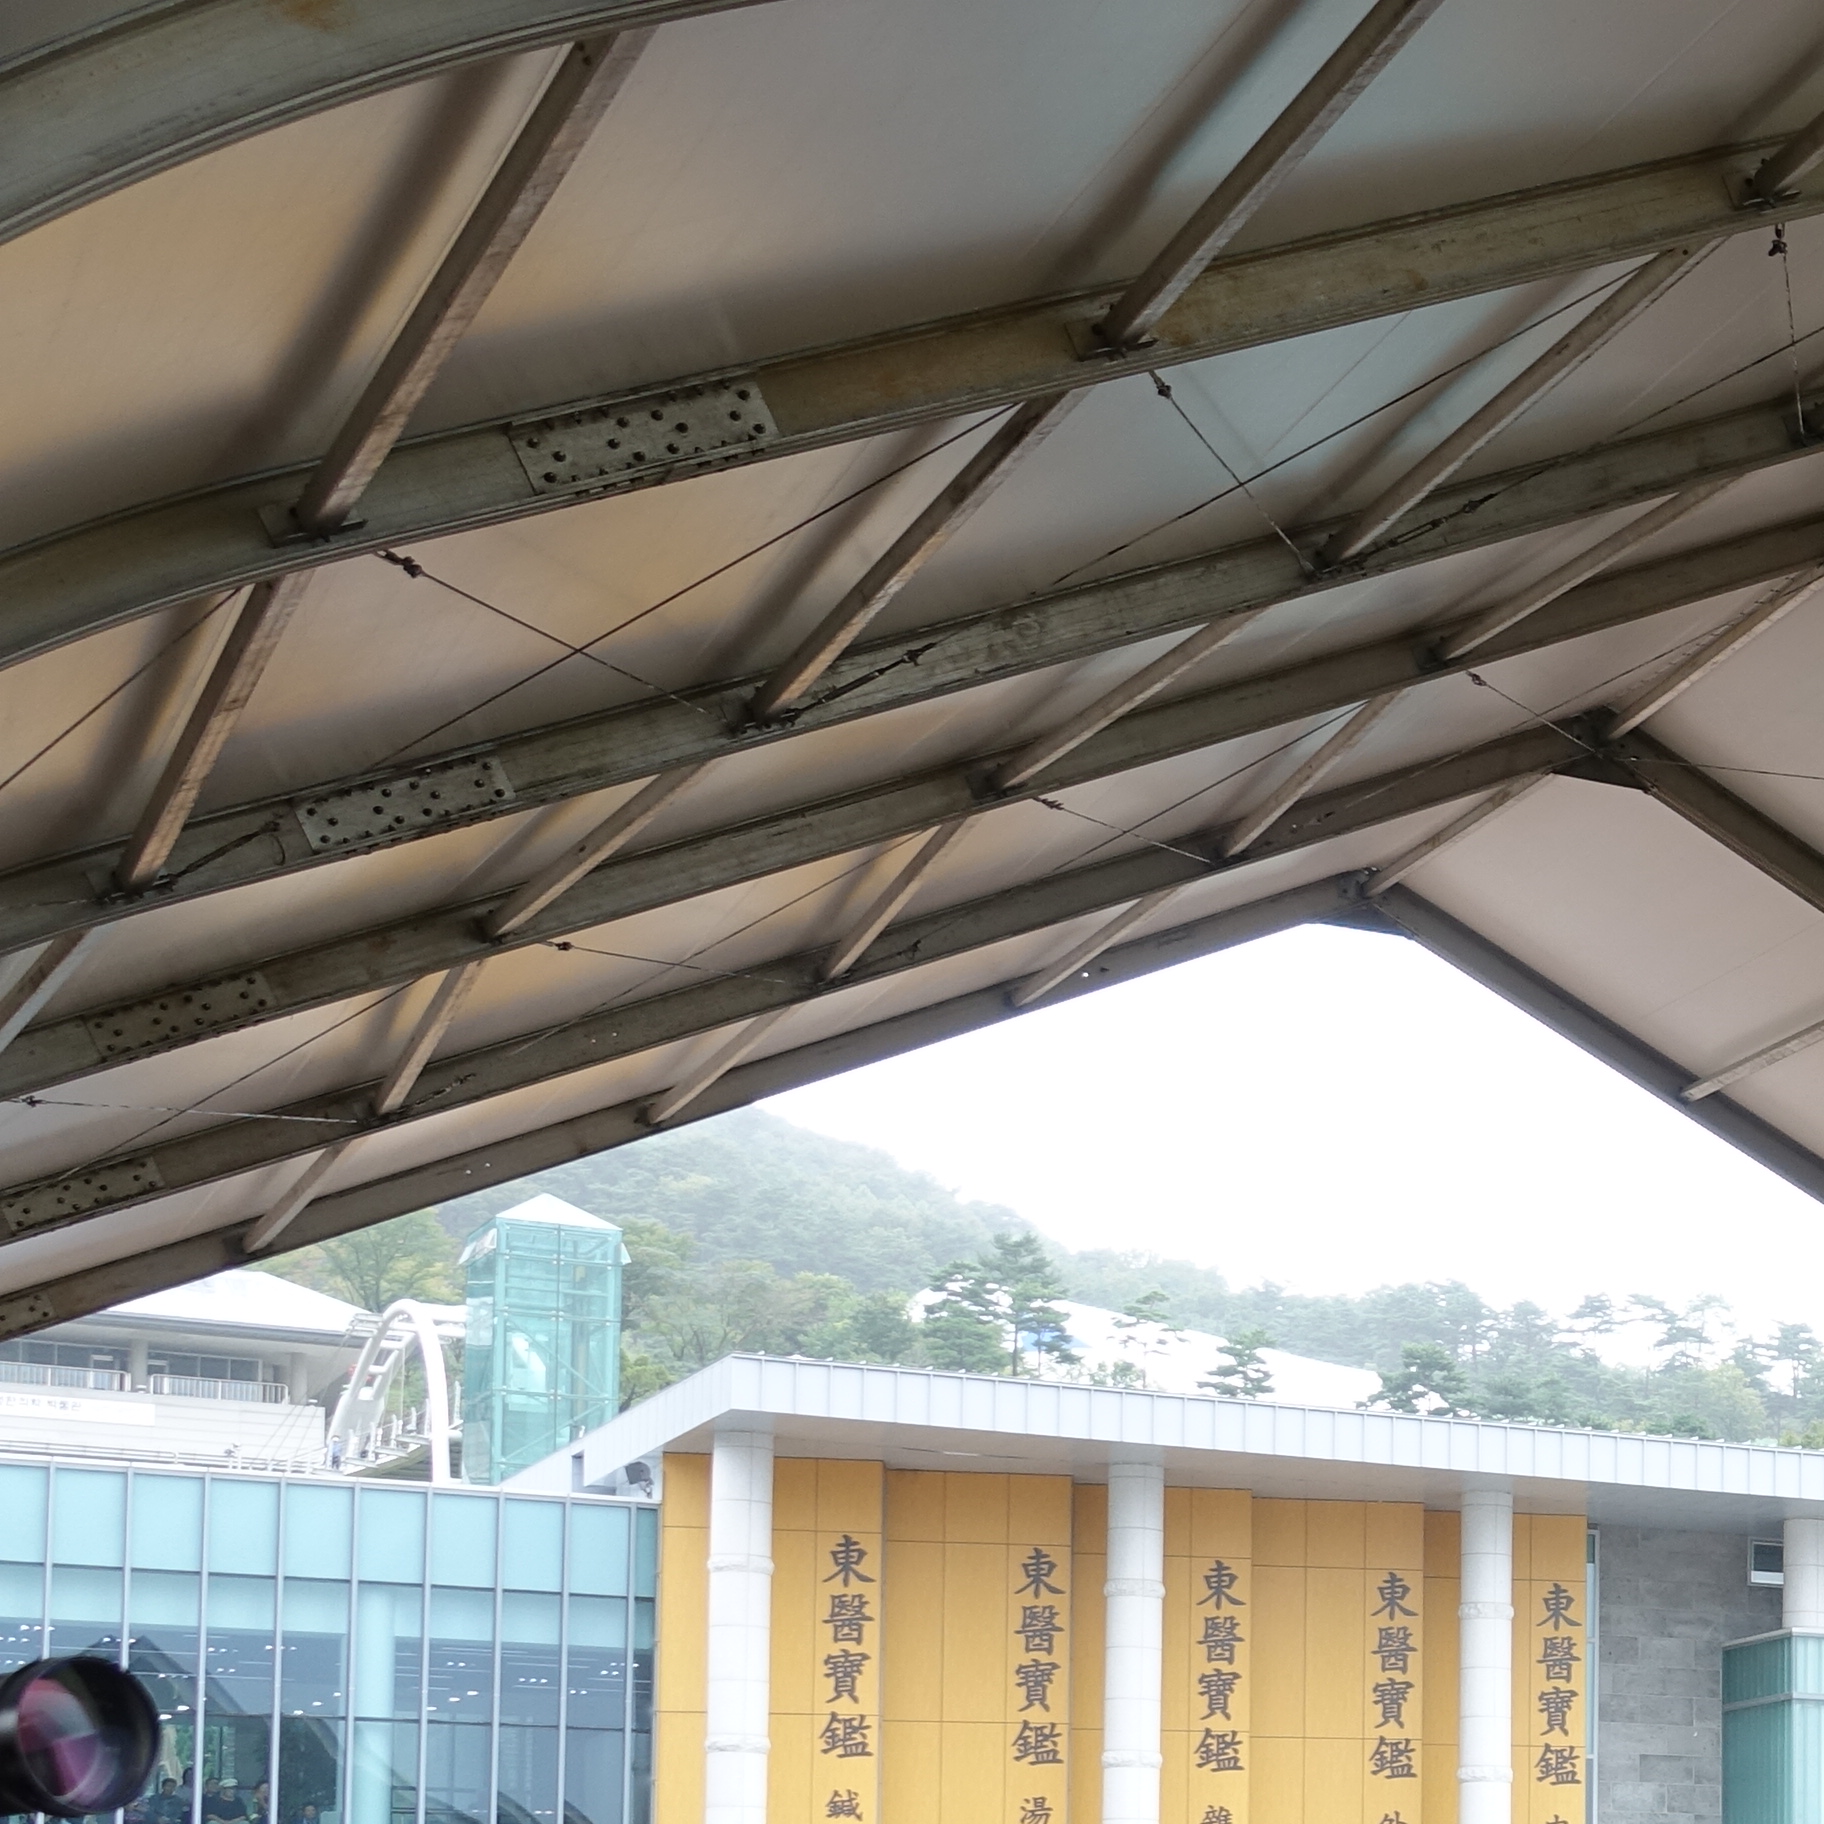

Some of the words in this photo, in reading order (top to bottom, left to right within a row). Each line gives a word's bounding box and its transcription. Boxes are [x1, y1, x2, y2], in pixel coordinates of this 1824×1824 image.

[819, 1534, 876, 1760] 東醫寶鑑
[1011, 1546, 1067, 1767] 東醫寶鑑
[1193, 1558, 1247, 1774] 東醫寶鑑
[1368, 1571, 1420, 1780] 東醫寶鑑
[1534, 1582, 1583, 1787] 東醫寶鑑
